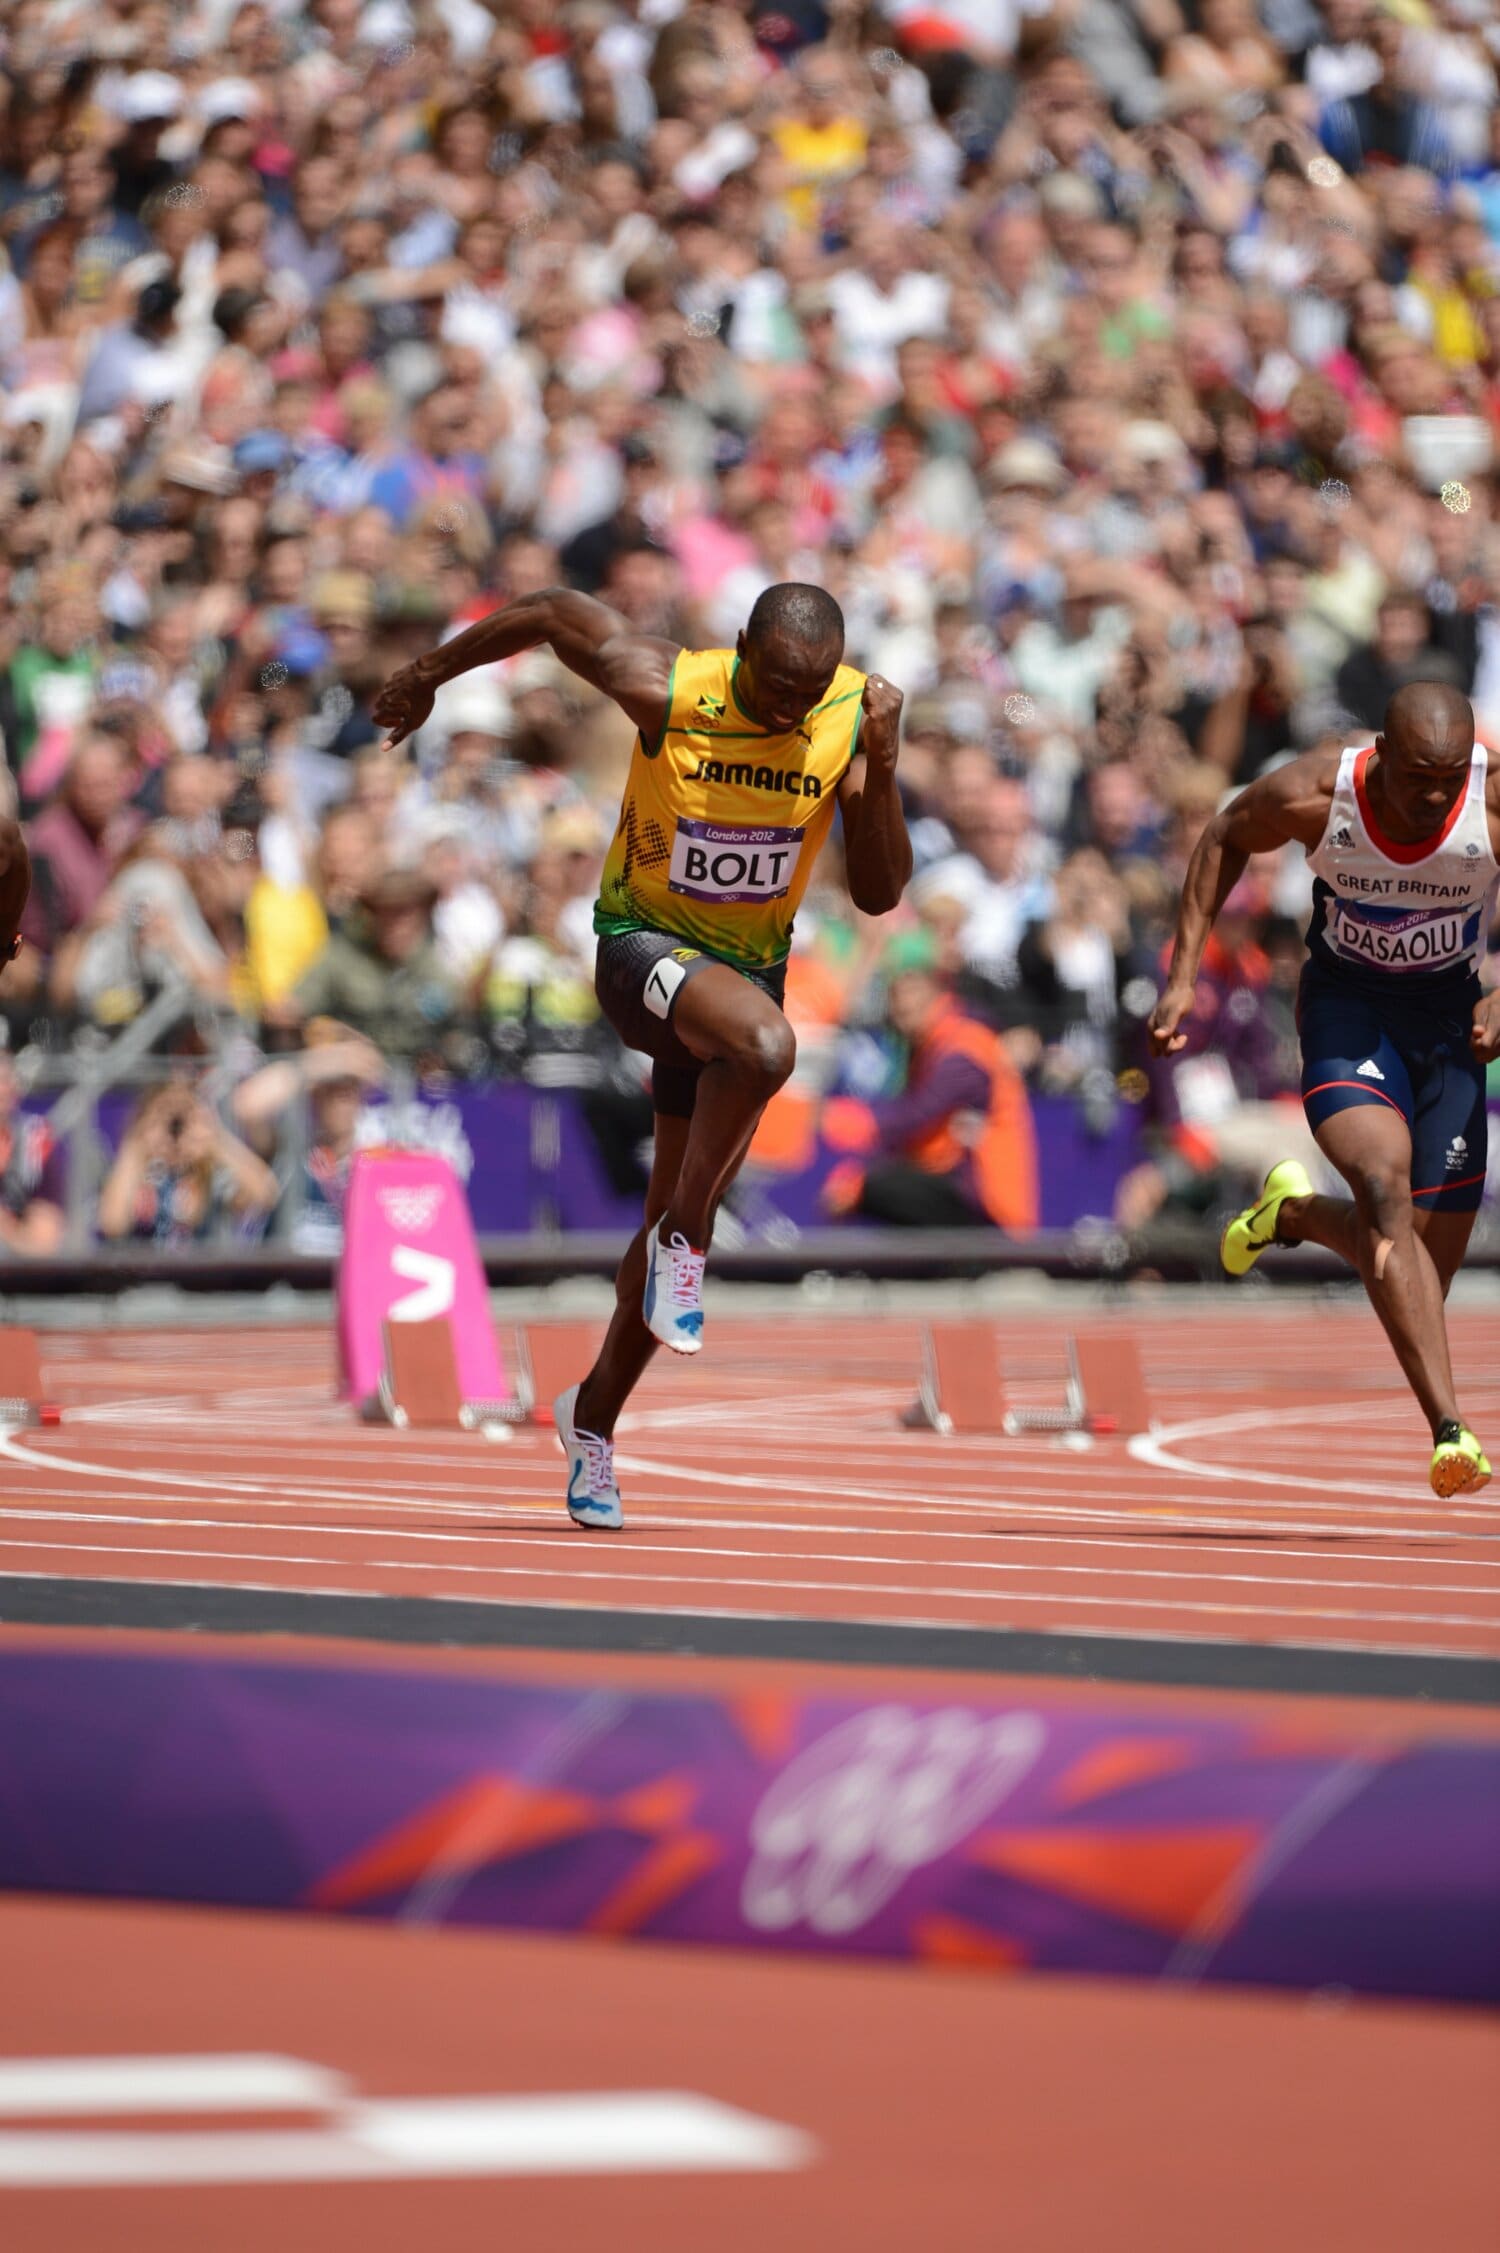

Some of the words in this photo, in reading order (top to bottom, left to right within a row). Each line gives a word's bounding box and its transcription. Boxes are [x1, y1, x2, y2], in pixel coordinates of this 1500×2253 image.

[683, 760, 822, 799] JAMAICA
[706, 827, 747, 842] London
[749, 831, 776, 842] 2012
[684, 846, 789, 887] BOLT
[1336, 872, 1394, 893] GREAT
[1397, 880, 1471, 897] BRITAIN
[1343, 921, 1457, 963] DASAOLU
[648, 970, 669, 1002] 7
